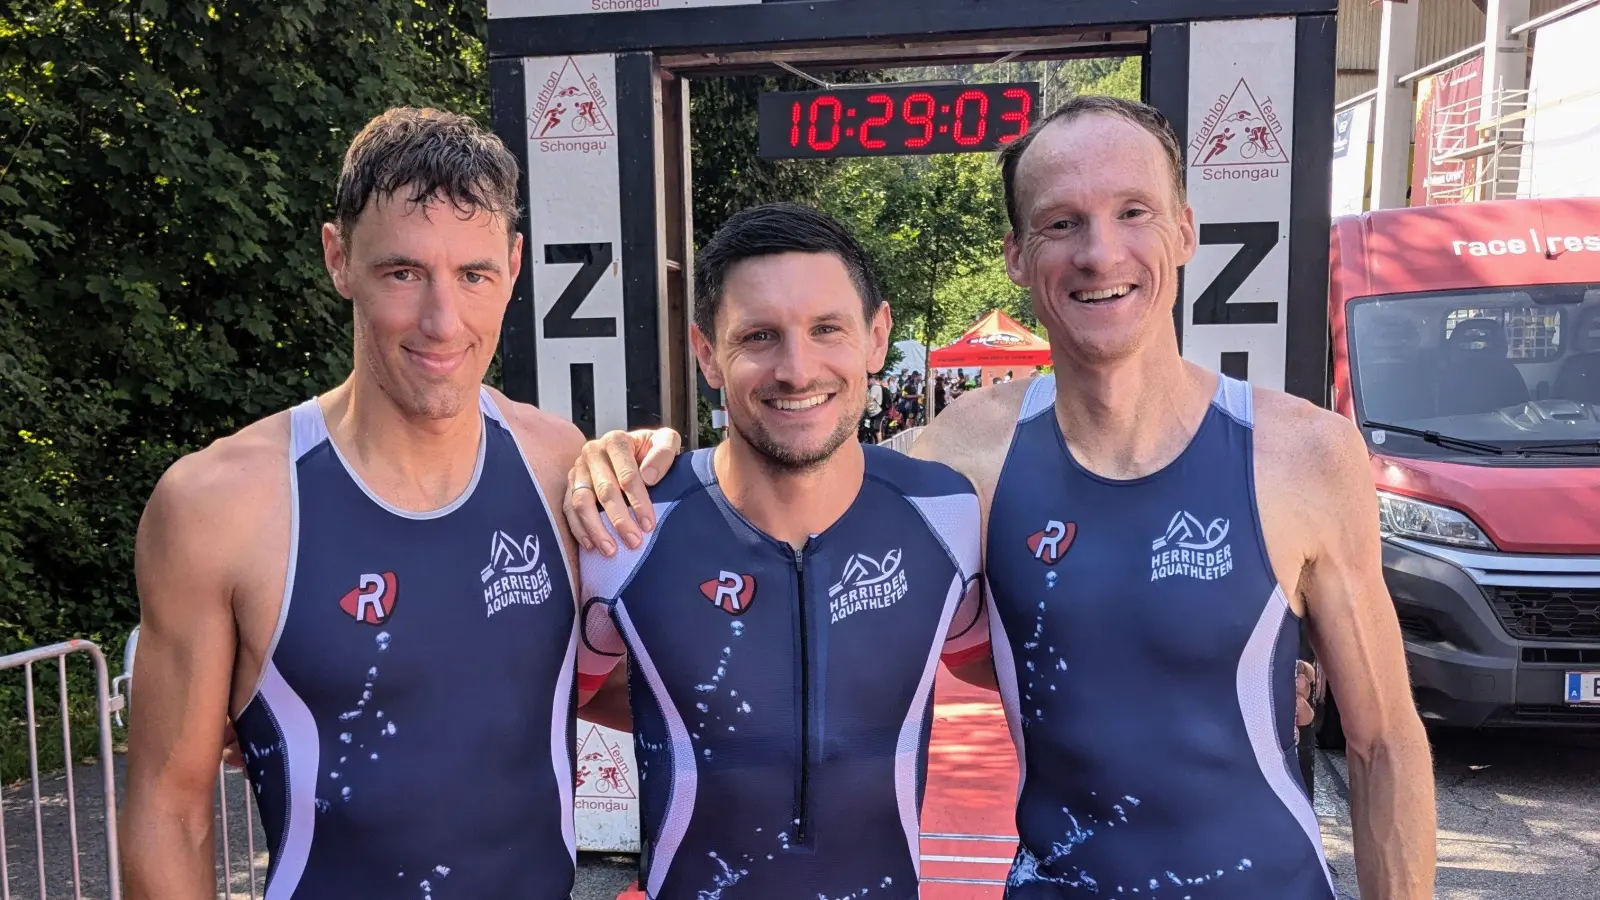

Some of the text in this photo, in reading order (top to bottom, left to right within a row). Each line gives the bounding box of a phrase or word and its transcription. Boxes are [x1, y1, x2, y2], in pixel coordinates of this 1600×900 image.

[591, 0, 660, 11] Schongau
[526, 70, 608, 125] Triathlon Team
[790, 88, 1032, 151] 10:29:03
[1187, 93, 1283, 151] Triathlon Team
[540, 140, 607, 154] Schongau
[1202, 167, 1279, 182] Schongau
[1035, 519, 1066, 559] R
[1151, 543, 1232, 569] HERRIEDER
[483, 562, 549, 604] HERRIEDER
[714, 570, 744, 610] R
[1150, 557, 1233, 582] AQUATHLETEN
[356, 573, 385, 621] R
[486, 577, 552, 619] AQUATHLETEN
[829, 568, 906, 613] HERRIEDER
[830, 580, 909, 625] AQUATHLETEN
[610, 741, 630, 775] Team
